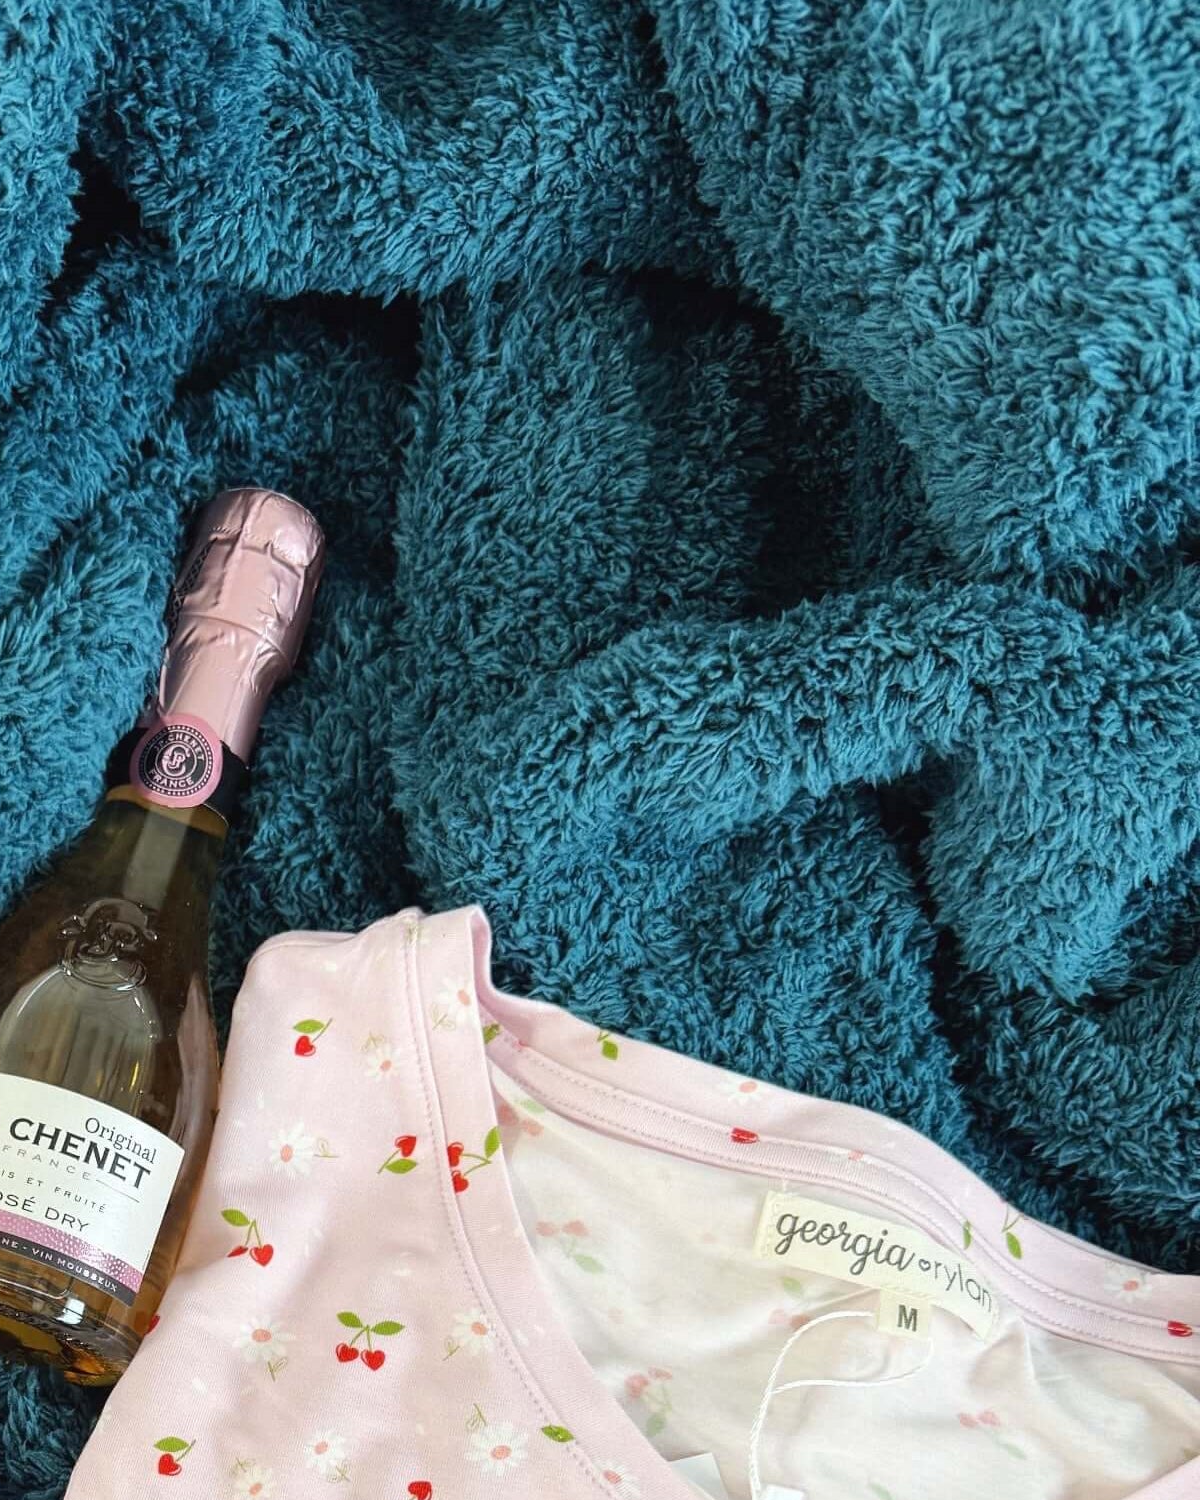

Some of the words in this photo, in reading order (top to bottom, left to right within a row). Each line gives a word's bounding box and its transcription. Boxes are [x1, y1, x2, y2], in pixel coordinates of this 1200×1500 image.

[148, 769, 195, 788] FRANCE
[9, 1116, 152, 1190] CHENET
[84, 1116, 159, 1164] Original
[1, 1144, 90, 1181] FRANCE
[26, 1176, 43, 1188] ET
[54, 1186, 108, 1213] FRUITÉ
[44, 1206, 91, 1233] DRY
[32, 1247, 53, 1263] VIN
[56, 1257, 119, 1292] MOUSSEUX
[774, 1213, 916, 1276] georgia
[934, 1262, 994, 1312] rylan
[896, 1304, 918, 1332] M
